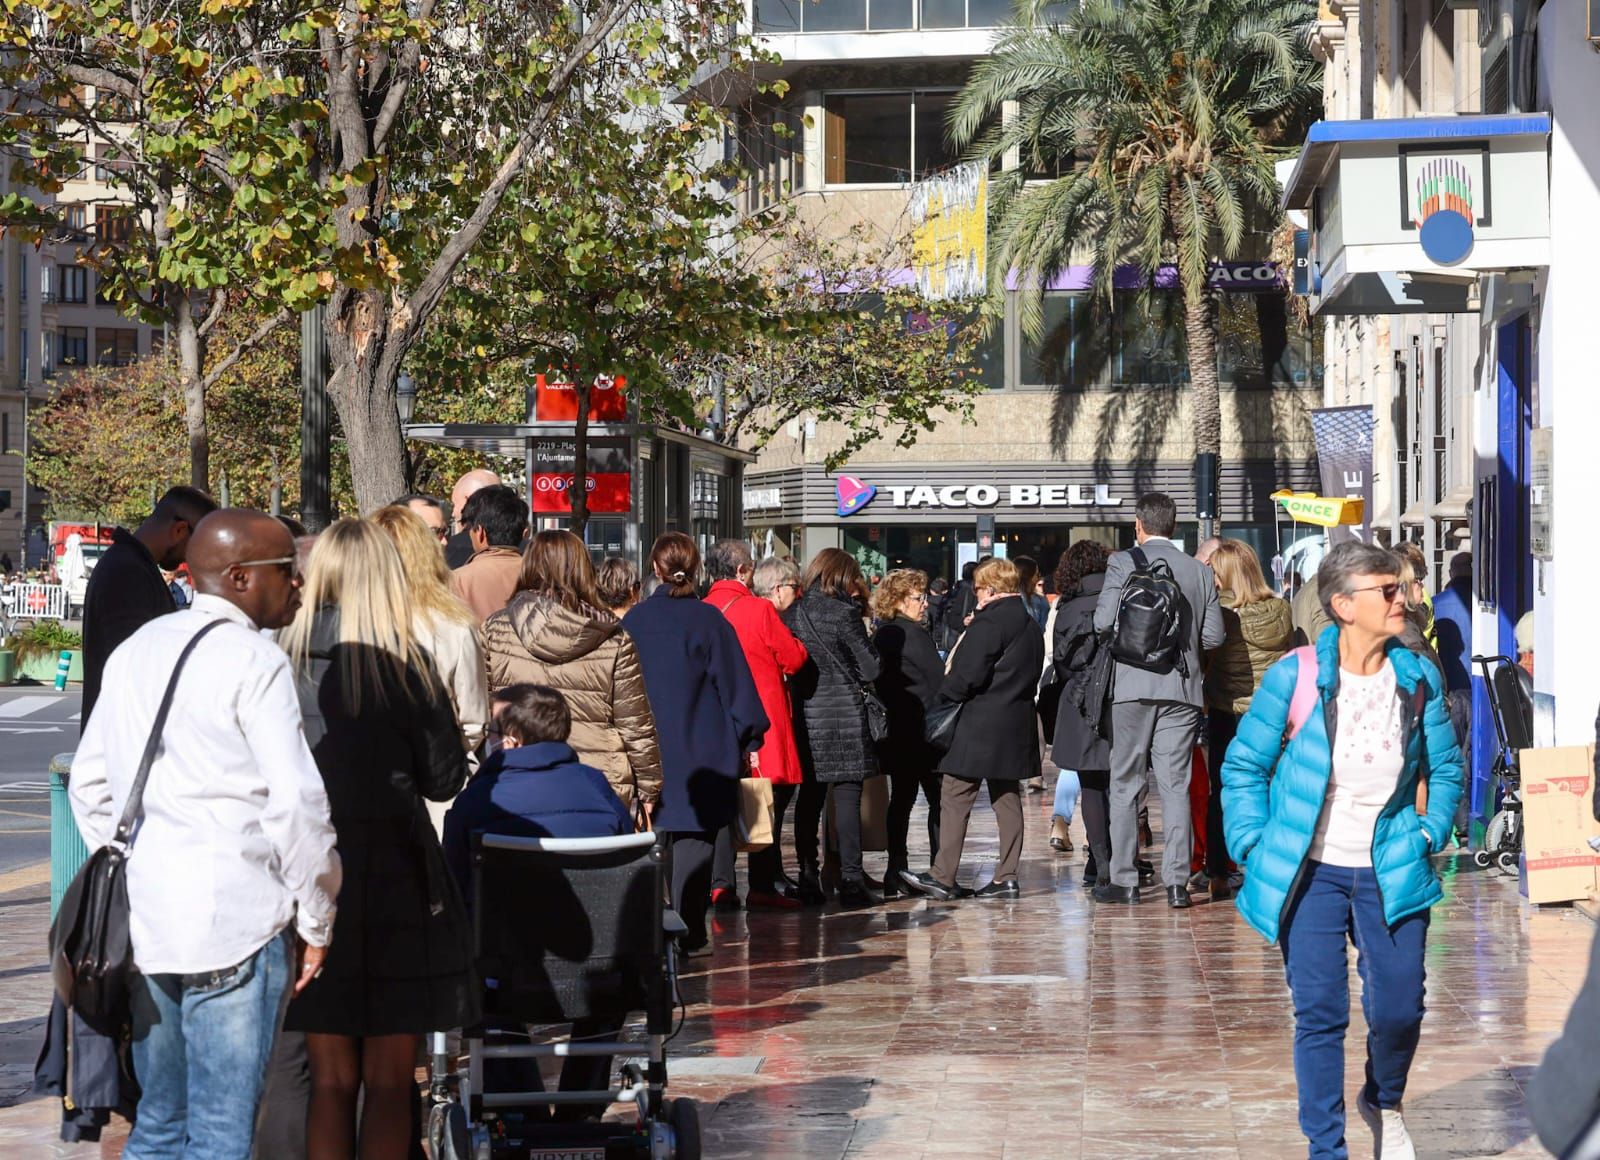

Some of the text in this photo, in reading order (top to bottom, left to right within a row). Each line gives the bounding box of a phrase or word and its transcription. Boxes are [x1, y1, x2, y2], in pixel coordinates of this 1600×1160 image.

[1207, 266, 1276, 282] ACO
[562, 442, 577, 452] Plaç
[537, 453, 577, 463] l'Ajuntame
[884, 485, 1122, 507] TACO BELL
[1291, 502, 1333, 517] ONCE
